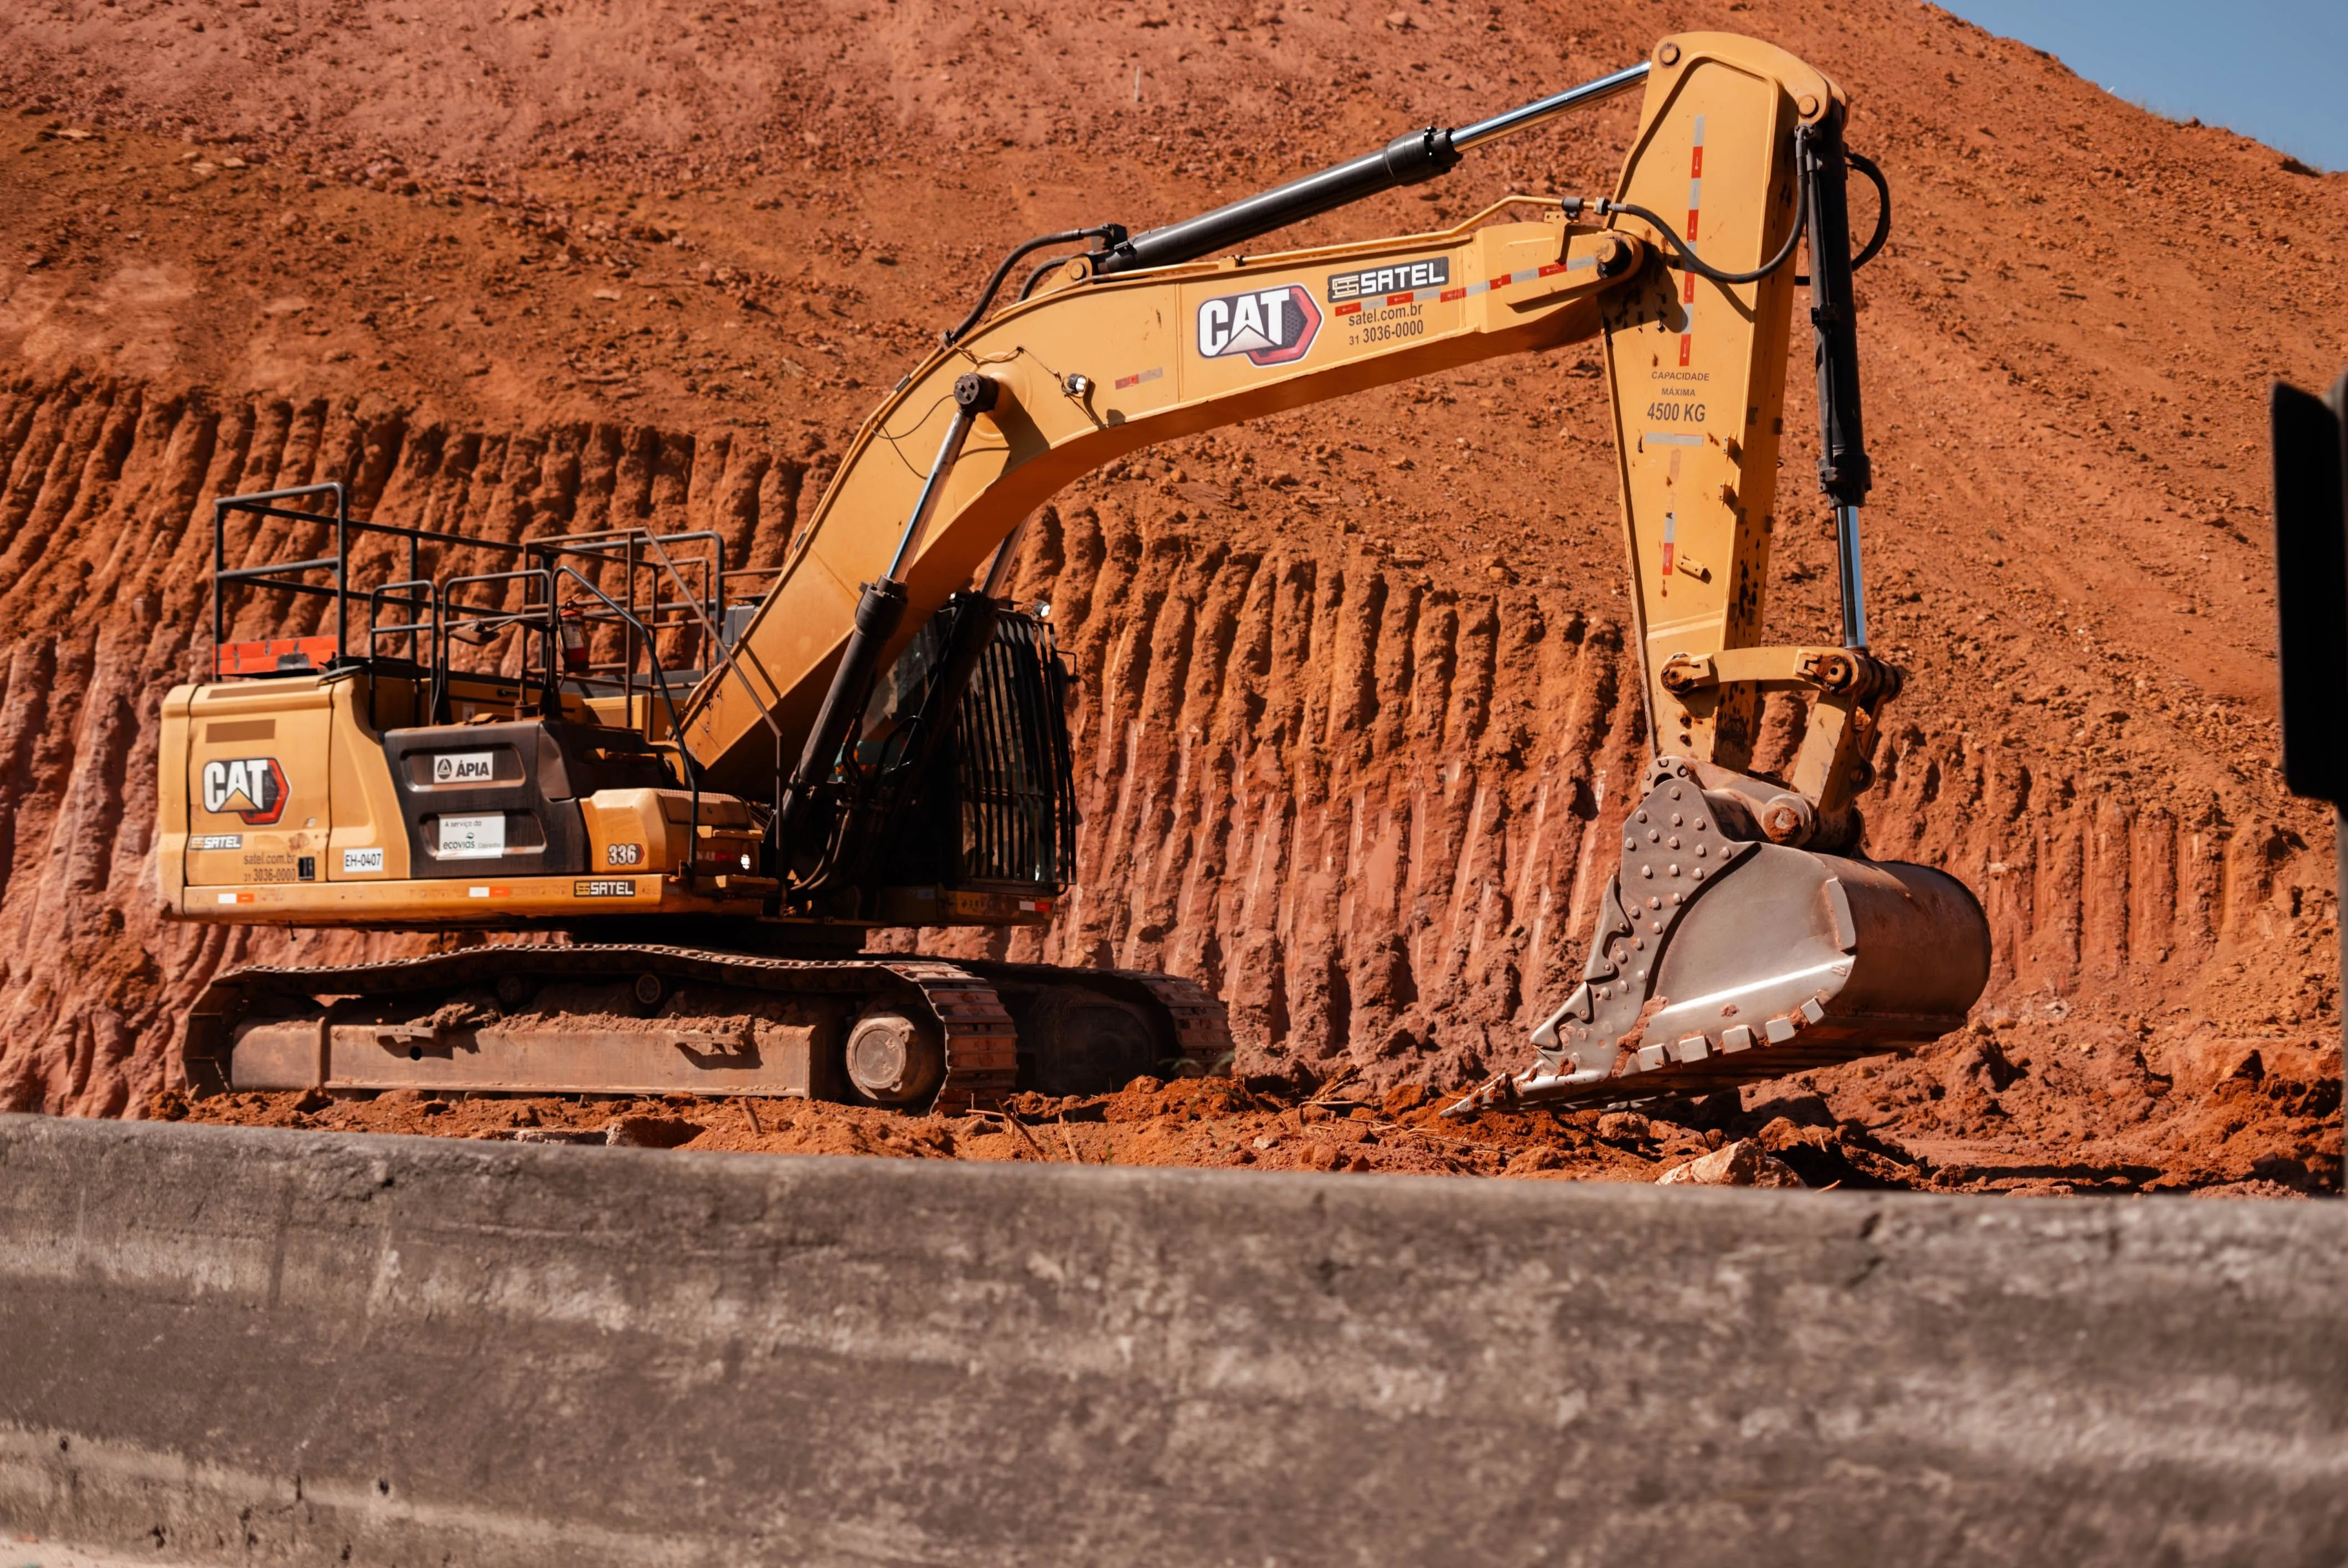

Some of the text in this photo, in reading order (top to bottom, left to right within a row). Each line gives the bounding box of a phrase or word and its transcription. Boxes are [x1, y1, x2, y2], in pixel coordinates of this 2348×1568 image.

[1361, 262, 1445, 293] SATEL
[1348, 302, 1423, 326] satel.com.br
[1199, 288, 1290, 357] CAT
[1349, 319, 1423, 345] 31 3036-0000
[1651, 372, 1709, 381] CAPACIDADE
[1661, 386, 1696, 396] MÁXIMA
[1647, 402, 1706, 422] 4500 KG
[456, 760, 490, 777] ÁPIA
[204, 759, 268, 812] CAT
[204, 836, 241, 848] SATEL
[443, 841, 475, 849] ecovias
[244, 852, 296, 865] satel.com.br
[346, 853, 381, 866] EH-0407
[609, 844, 636, 864] 336
[244, 868, 296, 881] 31 3036-0000
[590, 881, 634, 895] SATEL
